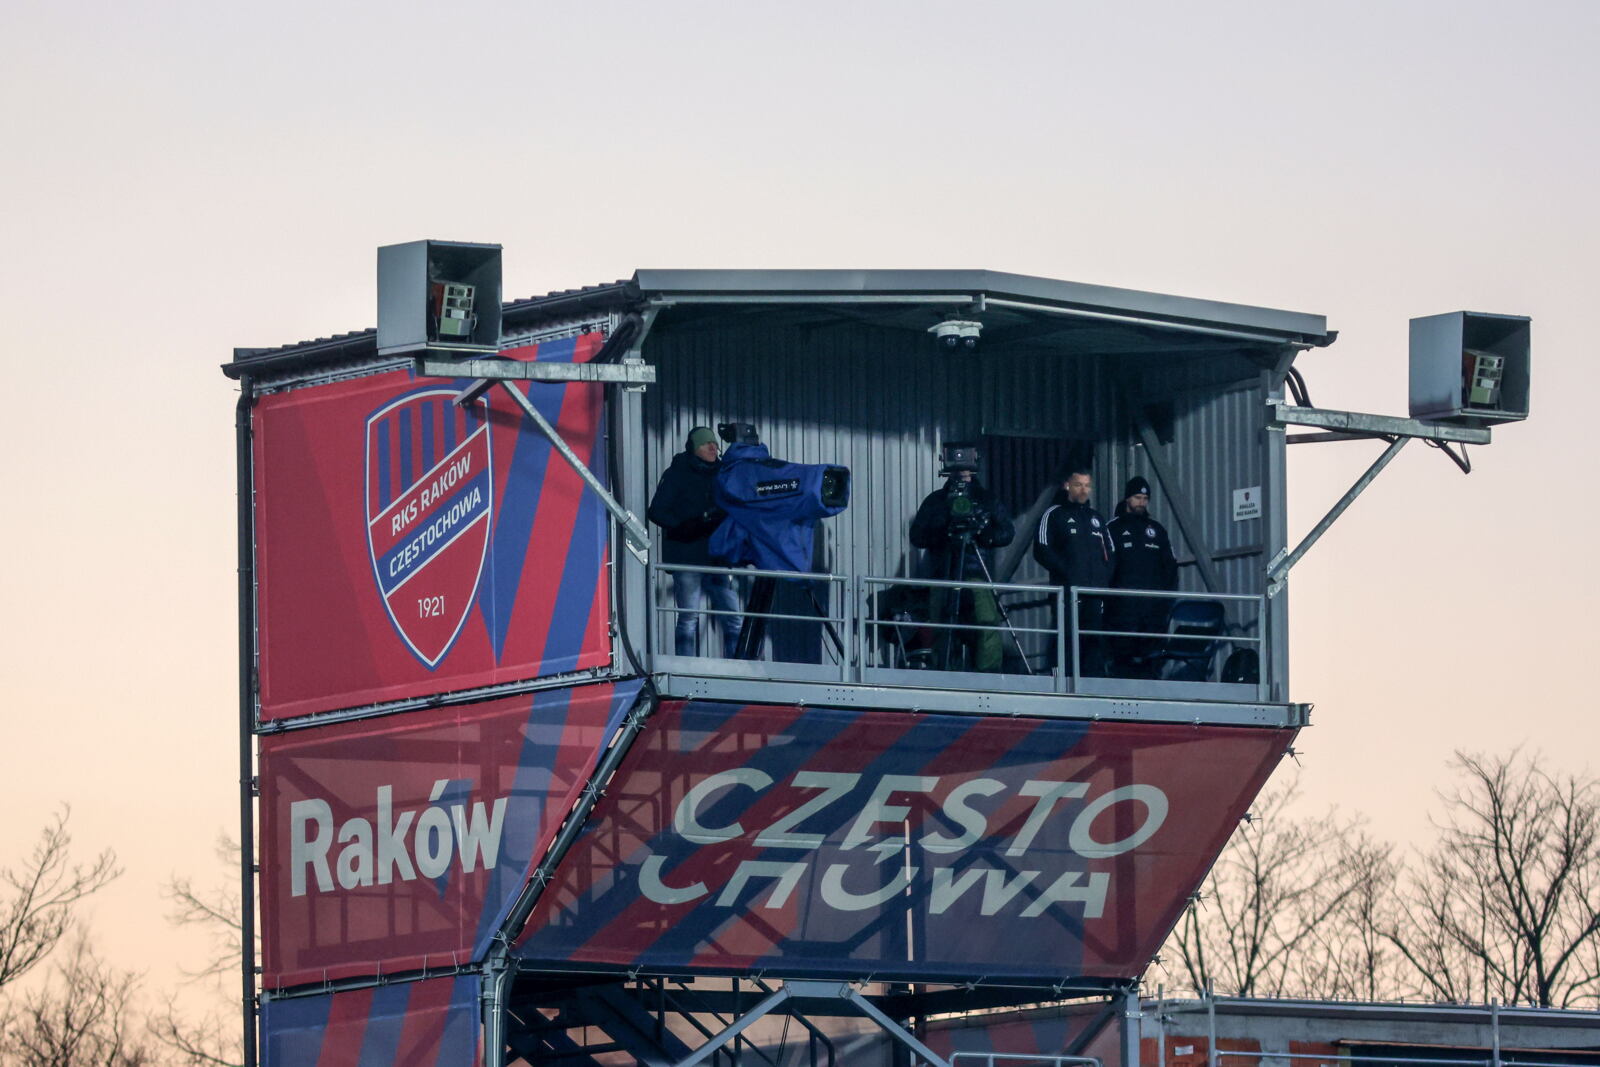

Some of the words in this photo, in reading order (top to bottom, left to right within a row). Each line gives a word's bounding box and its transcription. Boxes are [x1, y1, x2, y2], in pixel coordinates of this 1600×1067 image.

[390, 487, 481, 577] CZĘSTOCHOWA
[392, 500, 421, 537] RKS
[421, 452, 471, 510] RAKÓW
[417, 595, 445, 618] 1921
[290, 778, 509, 898] Raków
[674, 767, 1169, 866] CZĘSTO
